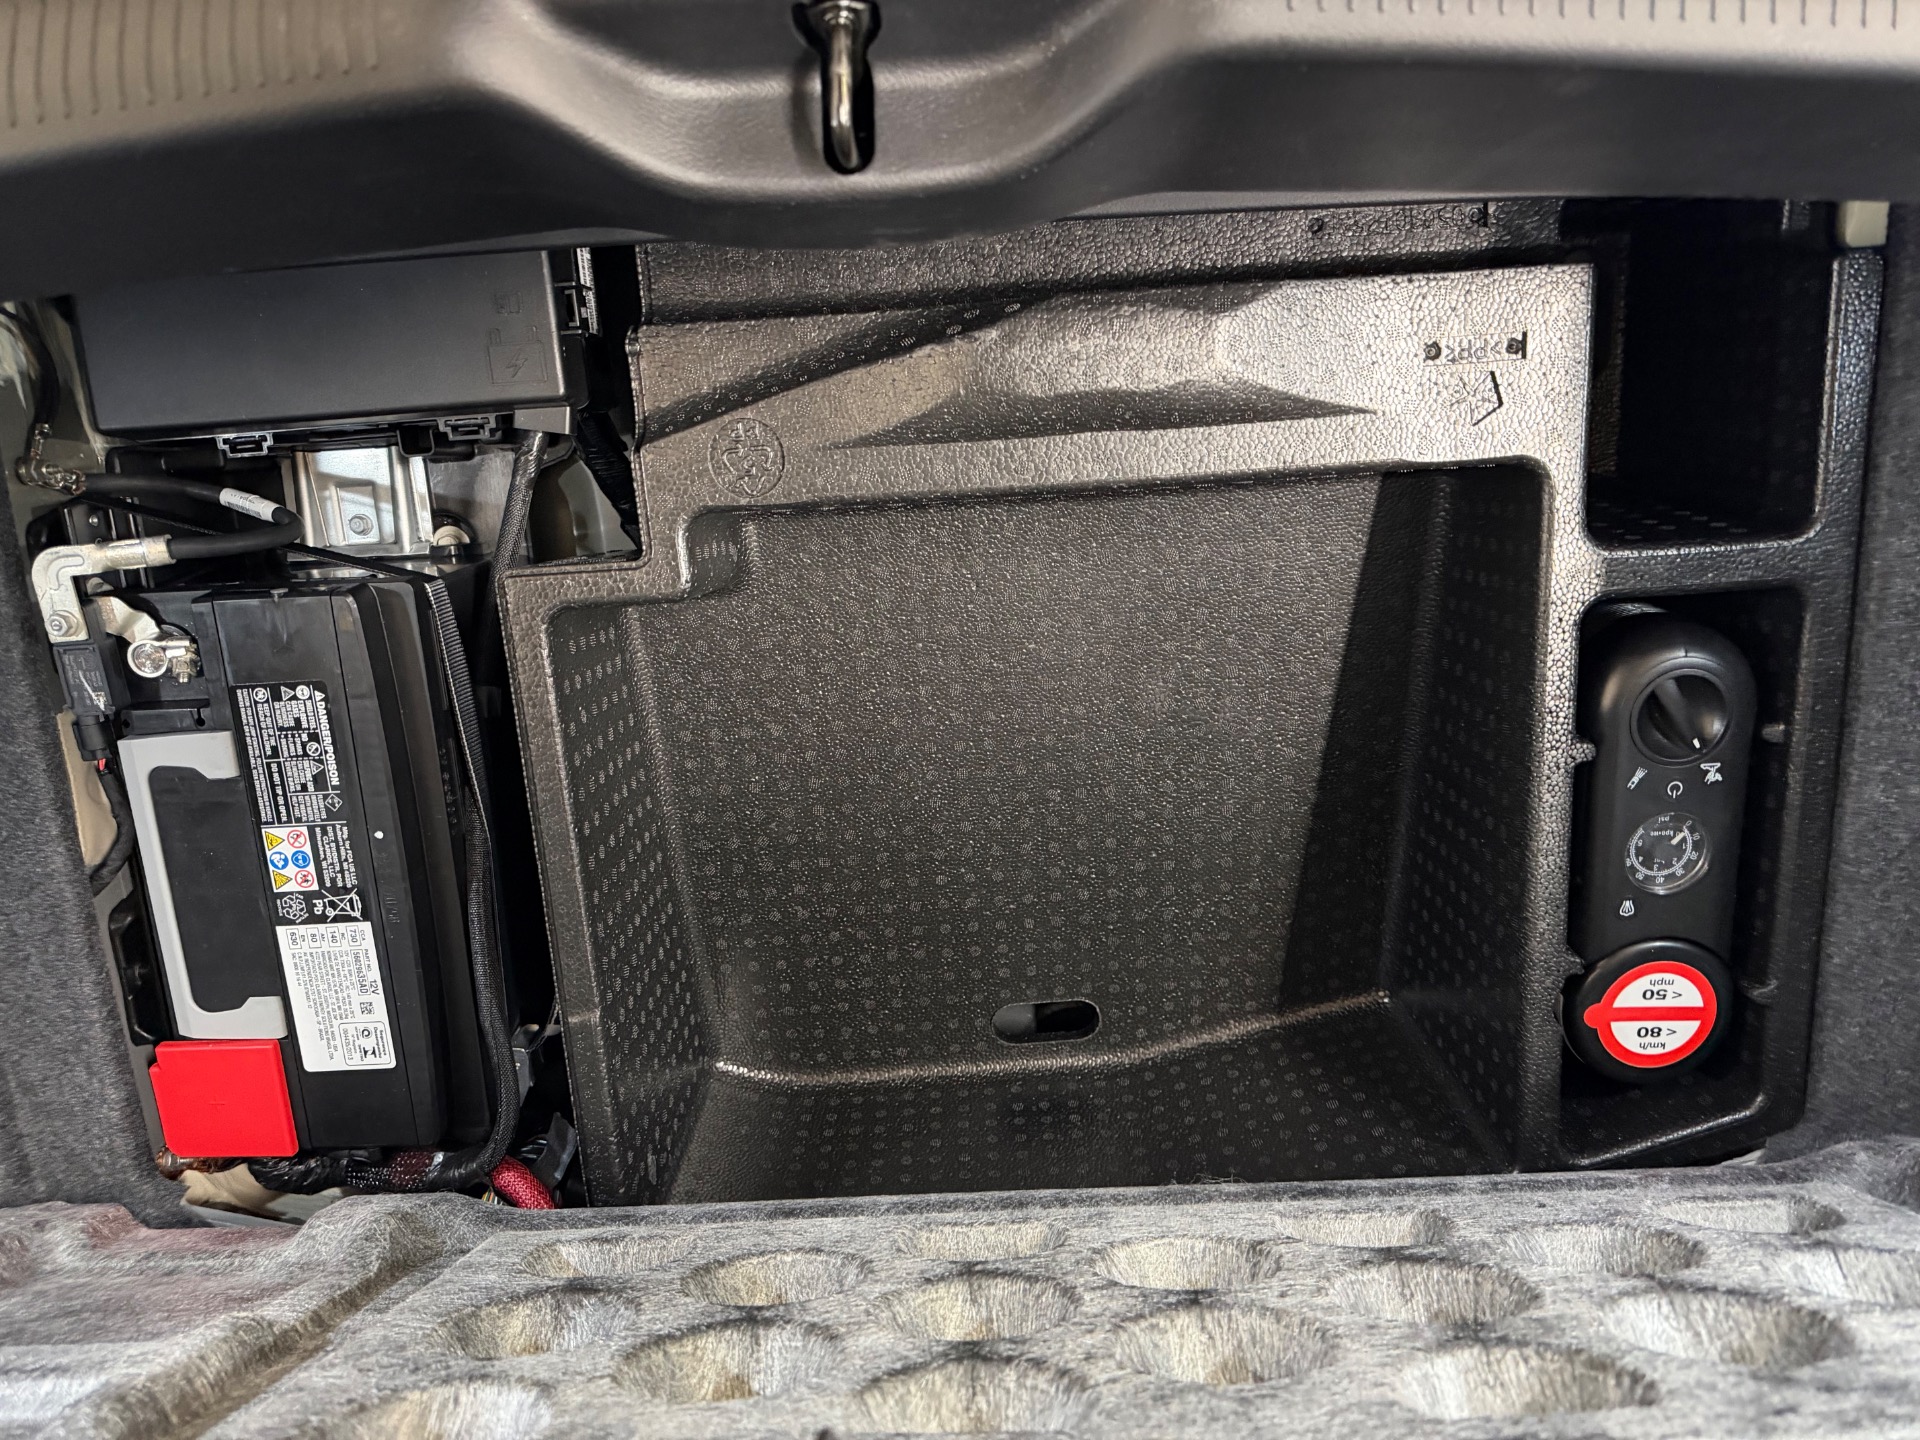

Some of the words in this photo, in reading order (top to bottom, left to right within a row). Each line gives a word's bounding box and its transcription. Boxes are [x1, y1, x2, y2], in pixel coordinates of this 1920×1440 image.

[257, 704, 266, 721] REACH
[263, 703, 271, 716] KEEP
[291, 700, 300, 718] GASES
[297, 700, 308, 728] EXPLOSIVE
[265, 717, 273, 728] OUT
[287, 711, 295, 727] CAUSE
[287, 738, 296, 756] FLAMES
[294, 738, 303, 755] SPARKS
[316, 701, 340, 786] DANGER/POISON
[270, 763, 278, 772] DO
[272, 772, 281, 785] NOT
[275, 786, 283, 795] TIP
[277, 796, 285, 805] OR
[335, 824, 344, 846] Auburn
[327, 826, 335, 842] DIST.
[335, 873, 343, 887] POR
[346, 850, 354, 862] FCA
[321, 860, 328, 869] WI
[349, 863, 355, 872] US
[328, 865, 336, 878] LLC
[1635, 872, 1645, 880] 50
[1675, 867, 1685, 876] 30
[323, 870, 331, 887] 53209
[350, 873, 358, 885] LLC
[312, 899, 325, 915] Pb
[289, 932, 299, 946] 630
[300, 934, 306, 942] EN
[310, 933, 318, 943] 80
[329, 930, 338, 944] 140
[340, 933, 346, 941] RC
[349, 929, 358, 943] 730
[352, 951, 369, 994] 56029635AD
[369, 979, 380, 995] 12V
[1649, 978, 1675, 987] mph
[1642, 989, 1668, 1000] 50
[1636, 1027, 1663, 1038] 80
[1639, 1042, 1666, 1050] km/h
